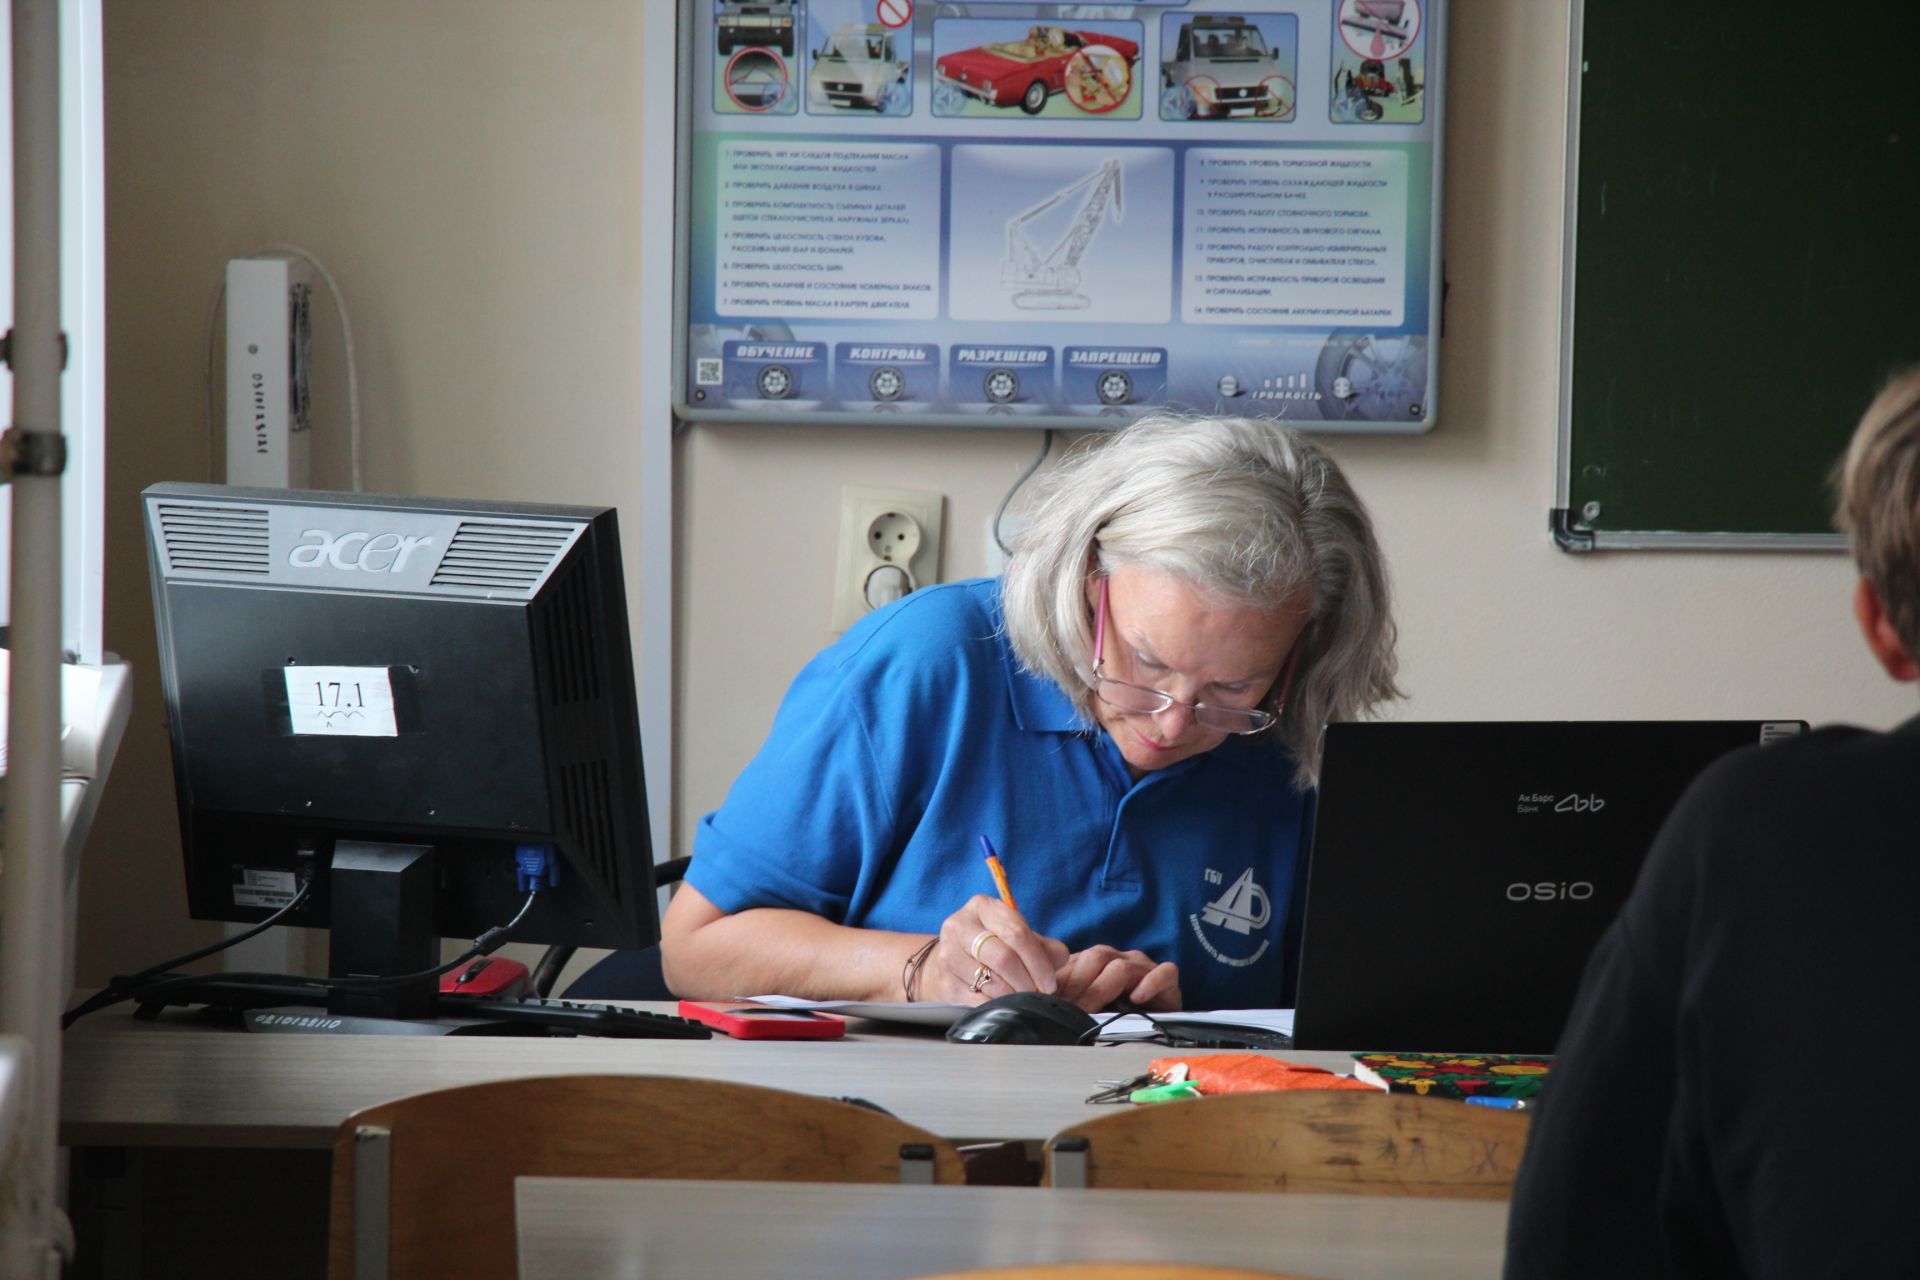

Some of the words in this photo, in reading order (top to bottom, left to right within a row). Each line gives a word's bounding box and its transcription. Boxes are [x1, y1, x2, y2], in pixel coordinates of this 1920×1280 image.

[737, 346, 815, 358] ОБУЧЕНИЕ
[850, 348, 926, 360] КОНТРОЛЬ
[958, 349, 1048, 362] РАЗРЕШЕНО
[1070, 351, 1161, 364] ЗАПРЕЩЕНО
[1251, 391, 1322, 400] ГРОМКОСТЬ
[288, 529, 435, 573] acer
[315, 681, 365, 707] 17.1
[1519, 794, 1530, 802] Ак
[1532, 793, 1554, 804] Барс
[1517, 804, 1539, 813] Банк
[1204, 868, 1223, 885] ГБУ
